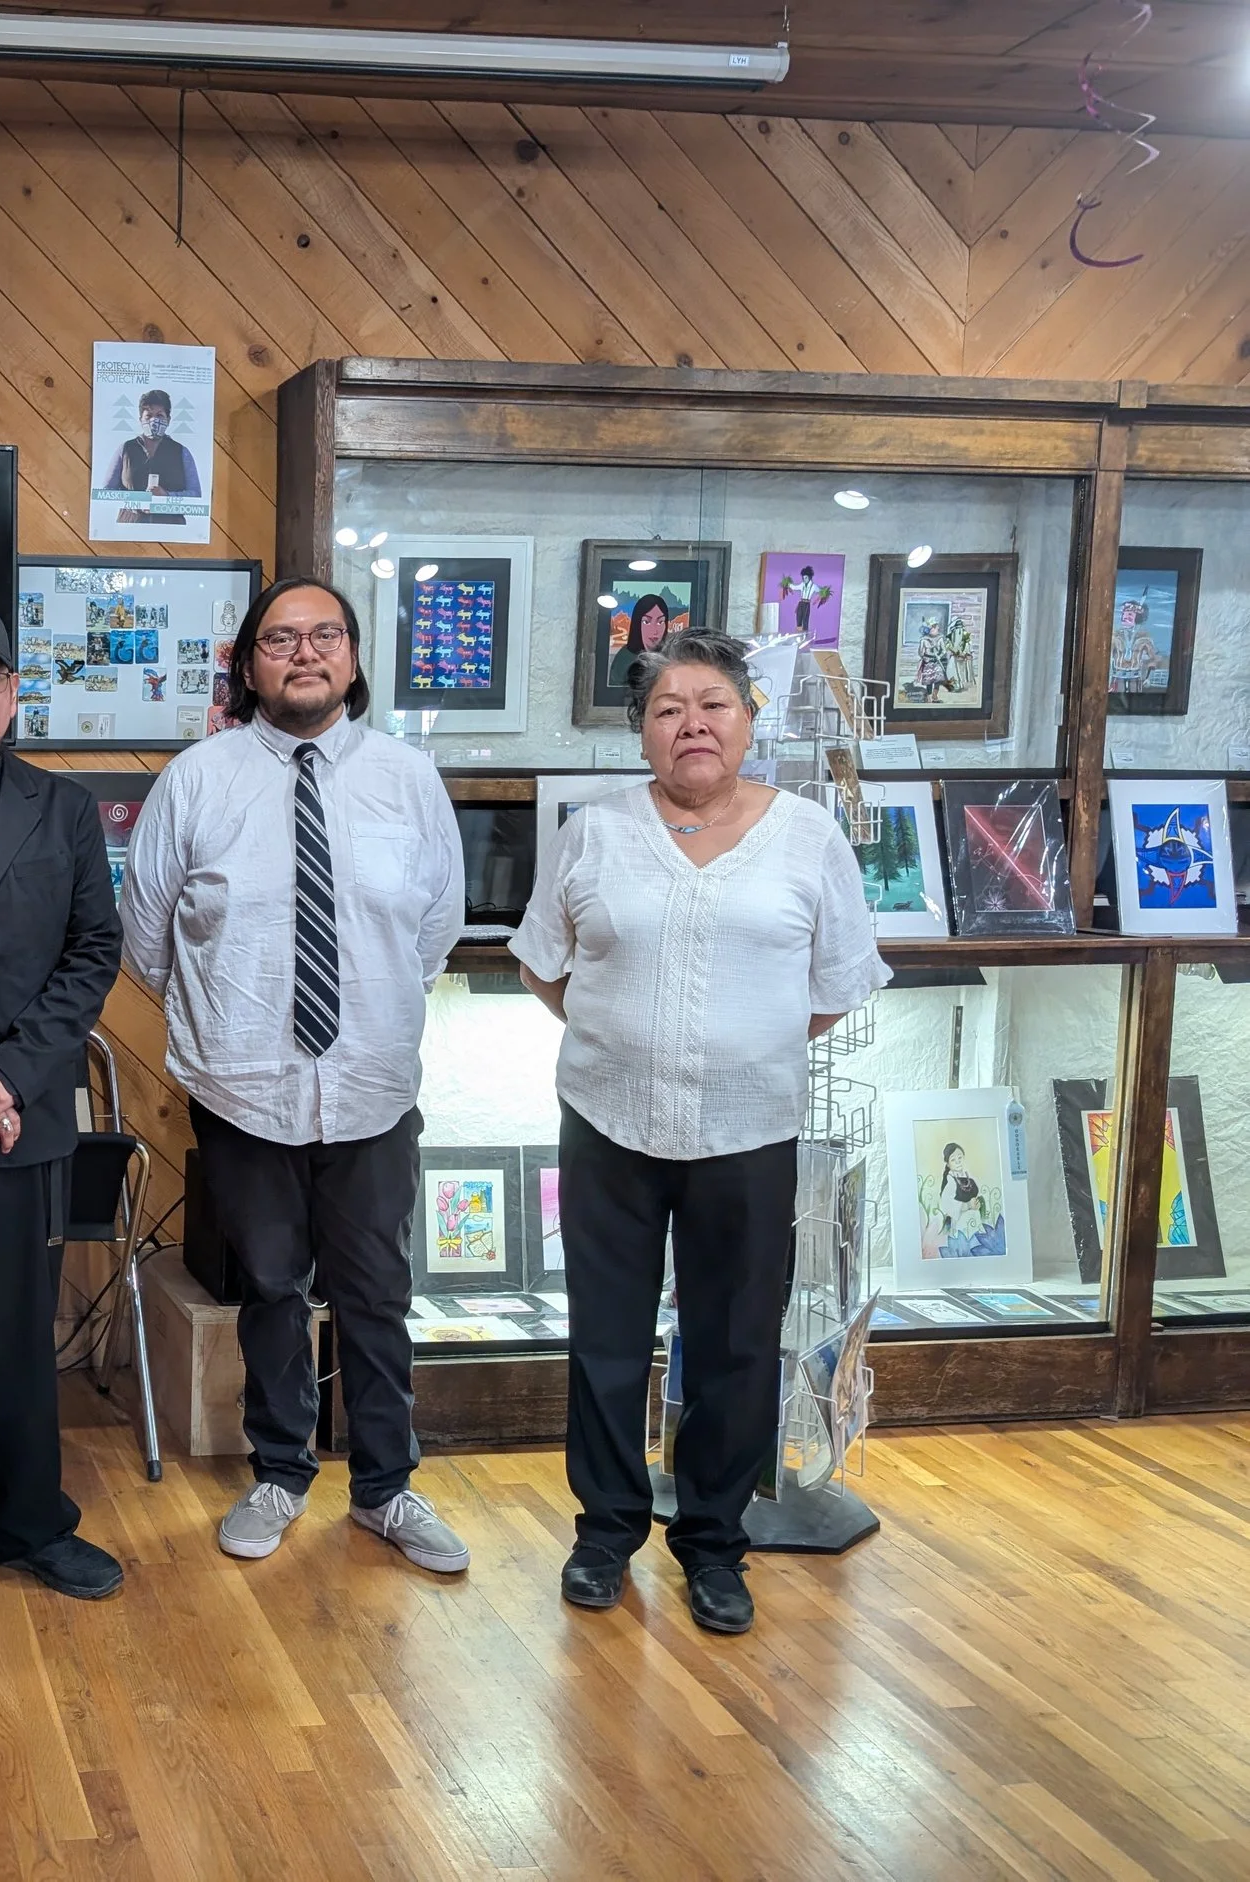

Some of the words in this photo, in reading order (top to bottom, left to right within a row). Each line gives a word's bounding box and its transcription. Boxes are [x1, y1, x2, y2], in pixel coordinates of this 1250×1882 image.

[732, 57, 747, 65] LYH
[96, 361, 131, 370] PROTECT
[132, 362, 150, 371] YOU
[96, 374, 134, 384] PROTECT
[136, 376, 150, 384] ME
[124, 501, 141, 509] ZUNI
